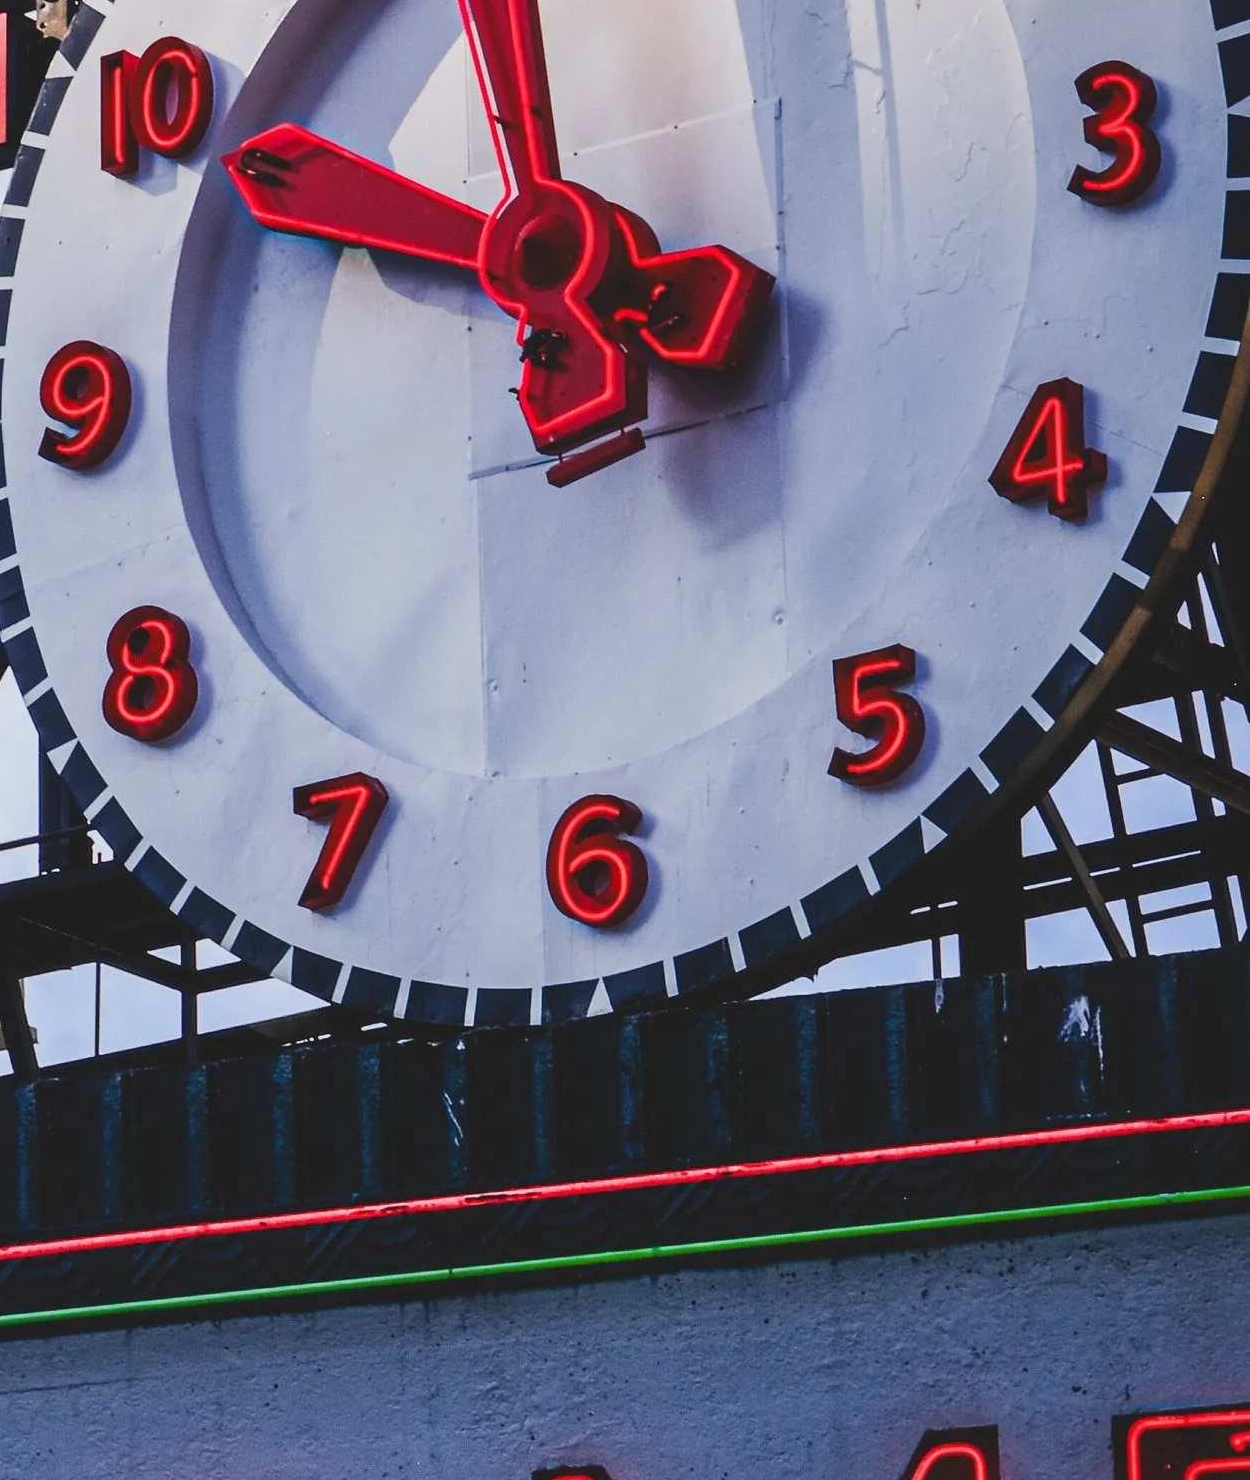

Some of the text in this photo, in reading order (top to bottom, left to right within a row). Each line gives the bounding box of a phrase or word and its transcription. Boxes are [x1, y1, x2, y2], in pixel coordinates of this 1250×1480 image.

[100, 37, 214, 178] 10
[1066, 60, 1161, 207] 3
[38, 340, 132, 470] 9
[989, 377, 1110, 519] 4
[103, 606, 198, 743] 8
[828, 644, 927, 788] 5
[293, 771, 389, 913] 7
[549, 794, 650, 929] 6
